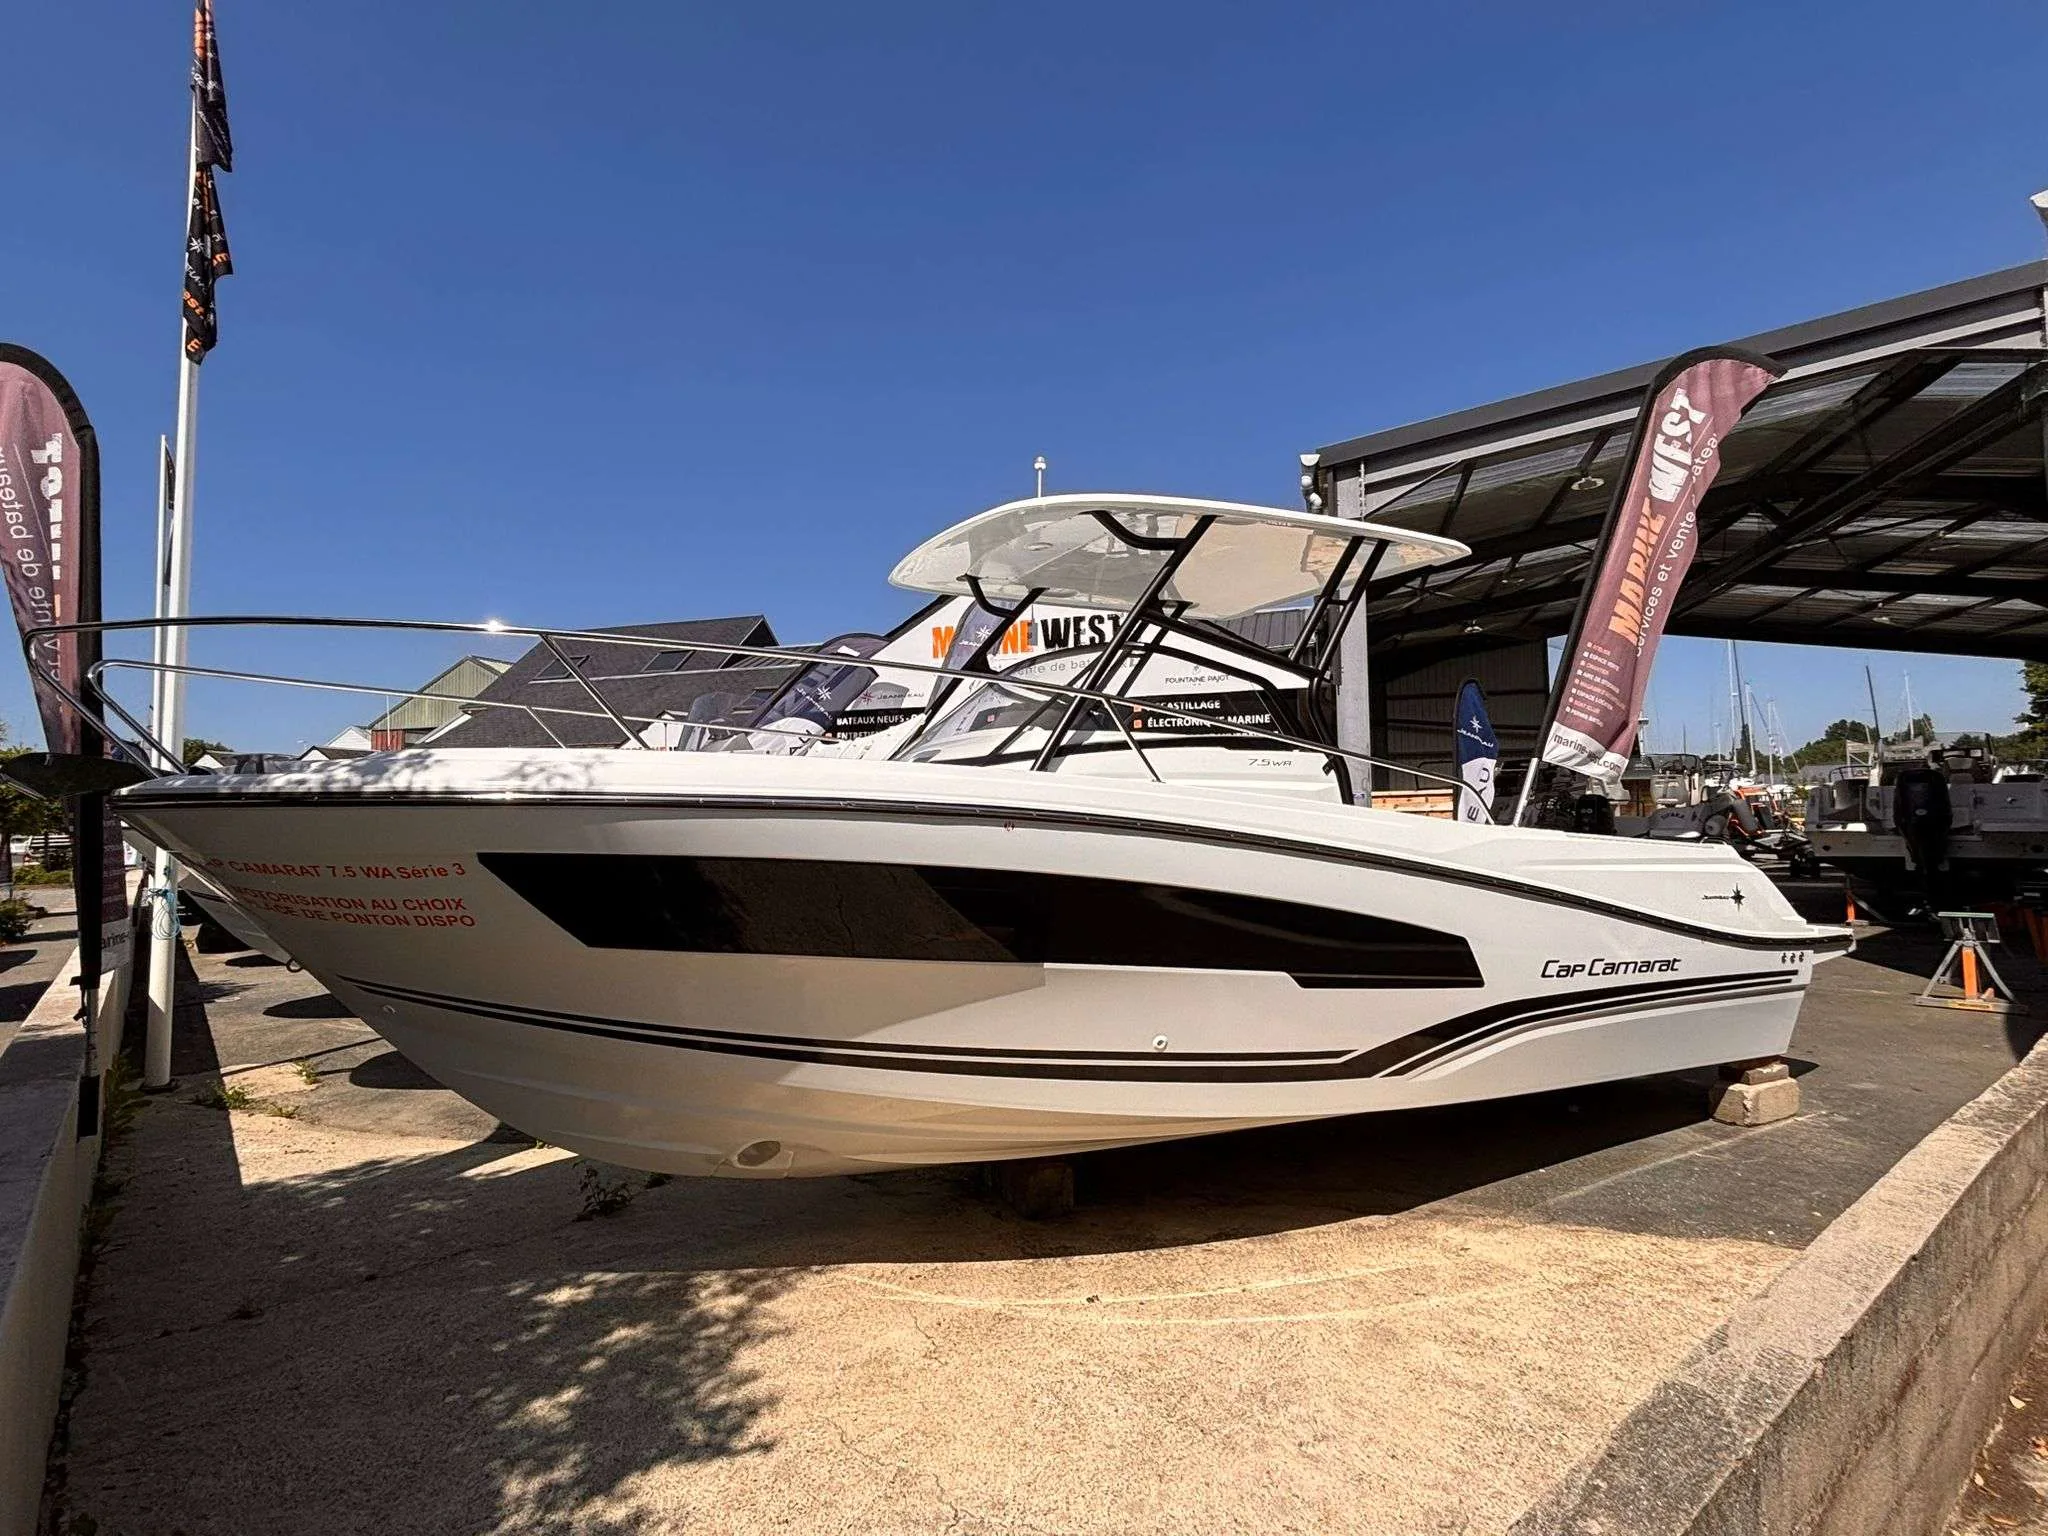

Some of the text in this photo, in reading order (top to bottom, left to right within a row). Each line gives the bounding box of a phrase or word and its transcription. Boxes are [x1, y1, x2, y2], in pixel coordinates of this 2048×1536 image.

[1648, 387, 1707, 503] WEST
[1657, 563, 1673, 582] et
[1666, 511, 1696, 559] vente
[932, 619, 1034, 659] MNE
[836, 715, 875, 726] BATEAUX
[877, 714, 905, 724] NEUFS
[1227, 713, 1271, 725] MARINE
[227, 860, 320, 877] CAMARAT
[326, 865, 357, 878] 7.5
[359, 865, 397, 879] WA
[396, 864, 449, 879] Série
[452, 862, 466, 876] 3
[371, 898, 398, 911] AU
[402, 898, 467, 911] CHOIX
[302, 908, 329, 921] DE
[331, 911, 411, 927] PONTON
[414, 914, 476, 928] DISPO
[1540, 957, 1682, 979] Cap Camarat
